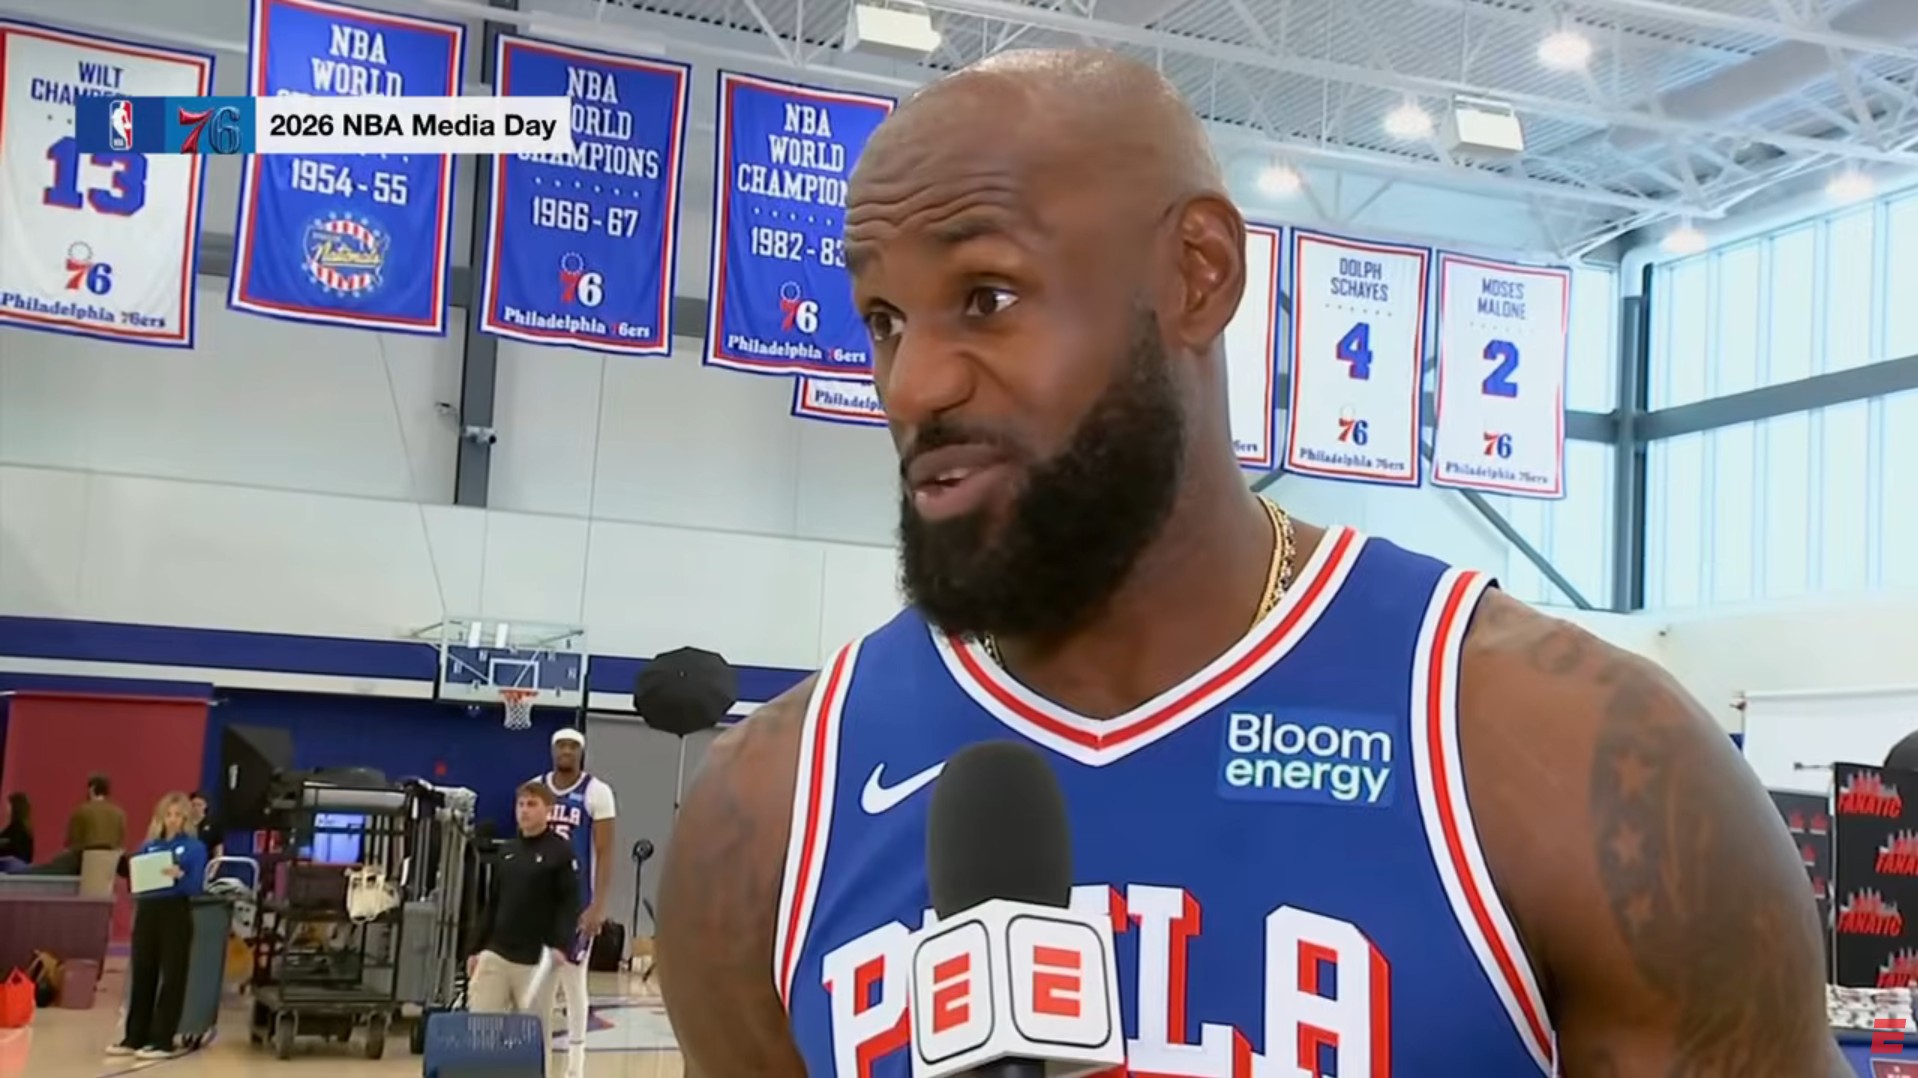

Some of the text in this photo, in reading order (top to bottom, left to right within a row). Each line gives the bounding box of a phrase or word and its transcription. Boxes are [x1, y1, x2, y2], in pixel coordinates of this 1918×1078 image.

[329, 24, 387, 65] NBA
[78, 60, 124, 89] WILT
[311, 57, 403, 97] WORLD
[566, 66, 619, 104] NBA
[572, 103, 632, 140] ORLD
[784, 102, 832, 138] NBA
[768, 134, 845, 172] WORLD
[43, 136, 148, 217] 13
[737, 163, 848, 207] CHAMPIO
[65, 258, 113, 295] 76
[1339, 257, 1382, 280] DOLPH
[559, 270, 604, 307] 76
[1330, 276, 1389, 302] SCHAYES
[1481, 277, 1525, 300] MOSES
[1, 291, 166, 328] Philadelphia 76ers
[504, 305, 651, 338] Philadelphia 76ers
[779, 298, 820, 333] 76
[1477, 296, 1526, 321] MALONE
[728, 333, 822, 361] Philadelphia
[1335, 321, 1374, 381] 4
[1481, 338, 1520, 399] 2
[815, 389, 887, 412] Philadelp
[1337, 417, 1369, 447] 76
[1482, 430, 1513, 460] 76
[1299, 446, 1406, 472] Philadelphia 76ers
[1445, 460, 1516, 481] Philadelphia
[1227, 712, 1392, 763] Bloom
[1225, 757, 1391, 803] energy
[547, 803, 581, 826] ILA
[822, 883, 1392, 1078] PLA
